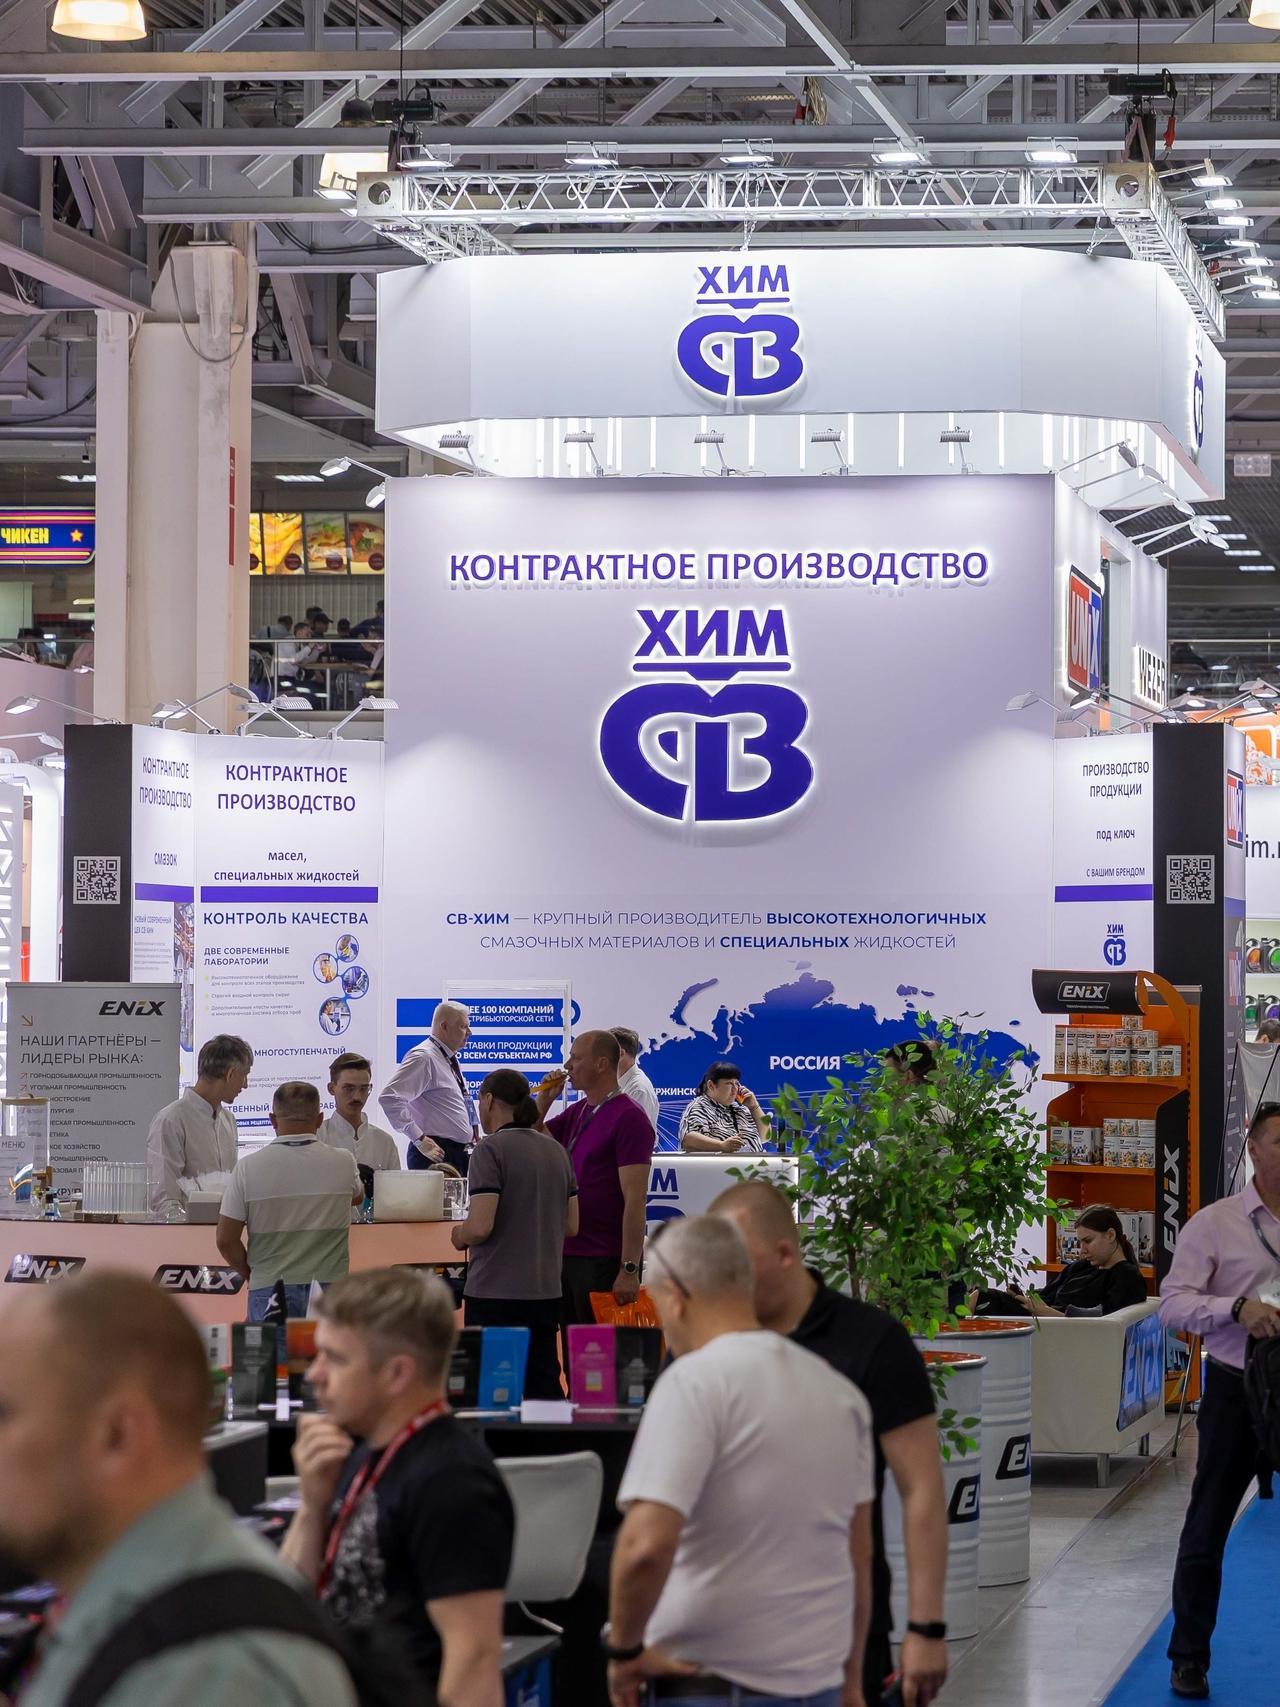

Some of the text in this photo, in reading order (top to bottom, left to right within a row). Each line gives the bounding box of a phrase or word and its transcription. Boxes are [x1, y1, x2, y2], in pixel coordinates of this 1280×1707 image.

[697, 265, 789, 295] ХИМ
[1, 528, 49, 544] ЧИКЕН
[450, 552, 989, 585] КОНТРАКТНОЕ ПРОИЗВОДСТВО
[634, 609, 788, 657] ХИМ
[142, 757, 189, 779] КОНТРАКТНОЕ
[225, 764, 348, 783] КОНТРАКТНОЕ
[1082, 761, 1150, 777] ПРОИЗВОДСТВО
[139, 786, 192, 809] ПРОИЗВОДСТВО
[1090, 783, 1142, 799] ПРОДУКЦИИ
[217, 793, 356, 814] ПРОИЗВОДСТВО
[1096, 828, 1135, 841] под ключ
[268, 851, 307, 863] масел,
[214, 868, 360, 882] специальных жидкостей
[1091, 868, 1115, 877] ВАШИМ
[1116, 867, 1145, 877] БРЕНДОМ
[203, 912, 369, 925] КОНТРОЛЬ КАЧЕСТВА
[446, 911, 987, 927] СВ-ХИМ КРУПНЫЙ ПРОИЗВОДИТЕЛЬ ВЫСОКОТЕХНОЛОГИЧНЫХ
[1106, 924, 1124, 934] ХИМ
[480, 933, 956, 950] СМАЗОЧНЫХ МАТЕРИАЛОВ И СПЕЦИАЛЬНЫХ ЖИДКОСТЕЙ
[204, 947, 290, 956] ДВЕ СОВРЕМЕННЫЕ
[204, 958, 269, 966] ЛАБОРАТОРИИ
[499, 1004, 554, 1014] КОМПАНИЙ
[20, 1033, 147, 1047] НАШИ ПАРТНЁРЫ
[463, 1042, 552, 1050] СТАВКИ ПРОДУКЦИИ
[254, 1046, 346, 1057] МНОГОСТУПЕНЧАТЫЙ
[488, 1052, 538, 1060] СУБЪЕКТАМ
[21, 1053, 143, 1066] ЛИДЕРЫ РЫНКА:
[769, 1056, 841, 1071] РОССИЯ
[655, 1087, 697, 1096] РЖИНСК
[225, 1103, 270, 1113] ТВЕННЫЙ
[64, 1142, 101, 1150] ХОЗЯЙСТВО
